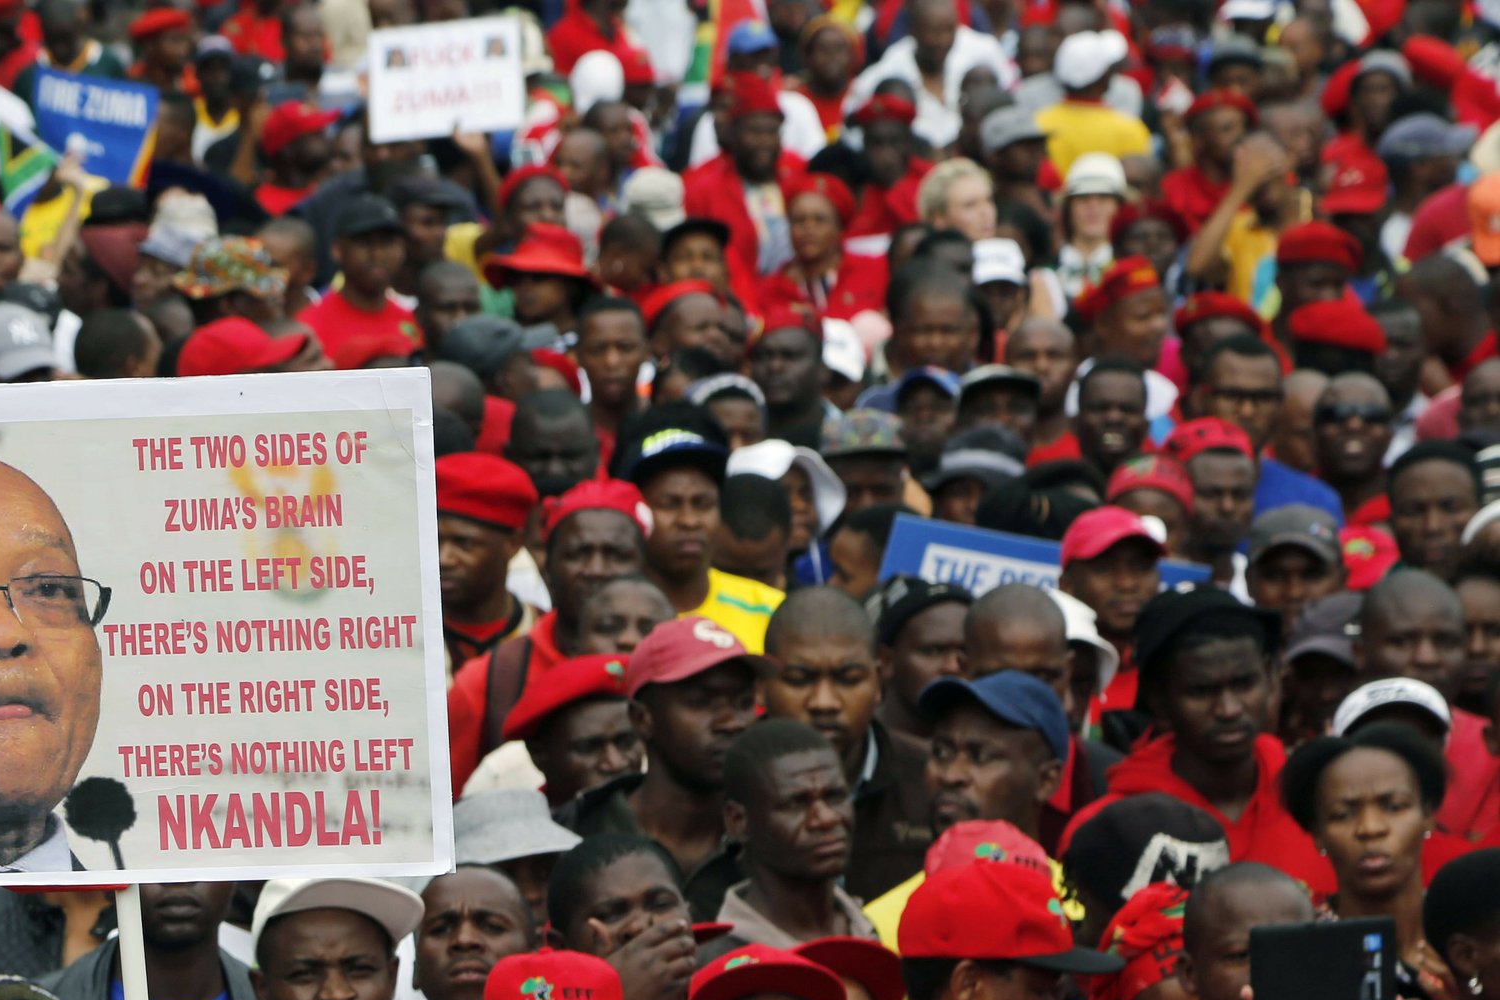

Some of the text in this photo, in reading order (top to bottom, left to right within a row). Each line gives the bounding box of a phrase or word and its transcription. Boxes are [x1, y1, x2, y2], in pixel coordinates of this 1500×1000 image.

[84, 85, 147, 129] ZUMA
[132, 431, 368, 471] THE TWO SIDES OF
[164, 494, 343, 532] ZUMA'S BRAIN
[140, 555, 374, 595] ON THE LEFT SIDE,
[932, 555, 990, 593] THE
[103, 615, 417, 656] THERE'S NOTHING RIGHT
[138, 678, 389, 717] ON THE RIGHT SIDE,
[118, 738, 414, 777] THERE'S NOTHING LEFT
[157, 789, 382, 850] NKANDLA!
